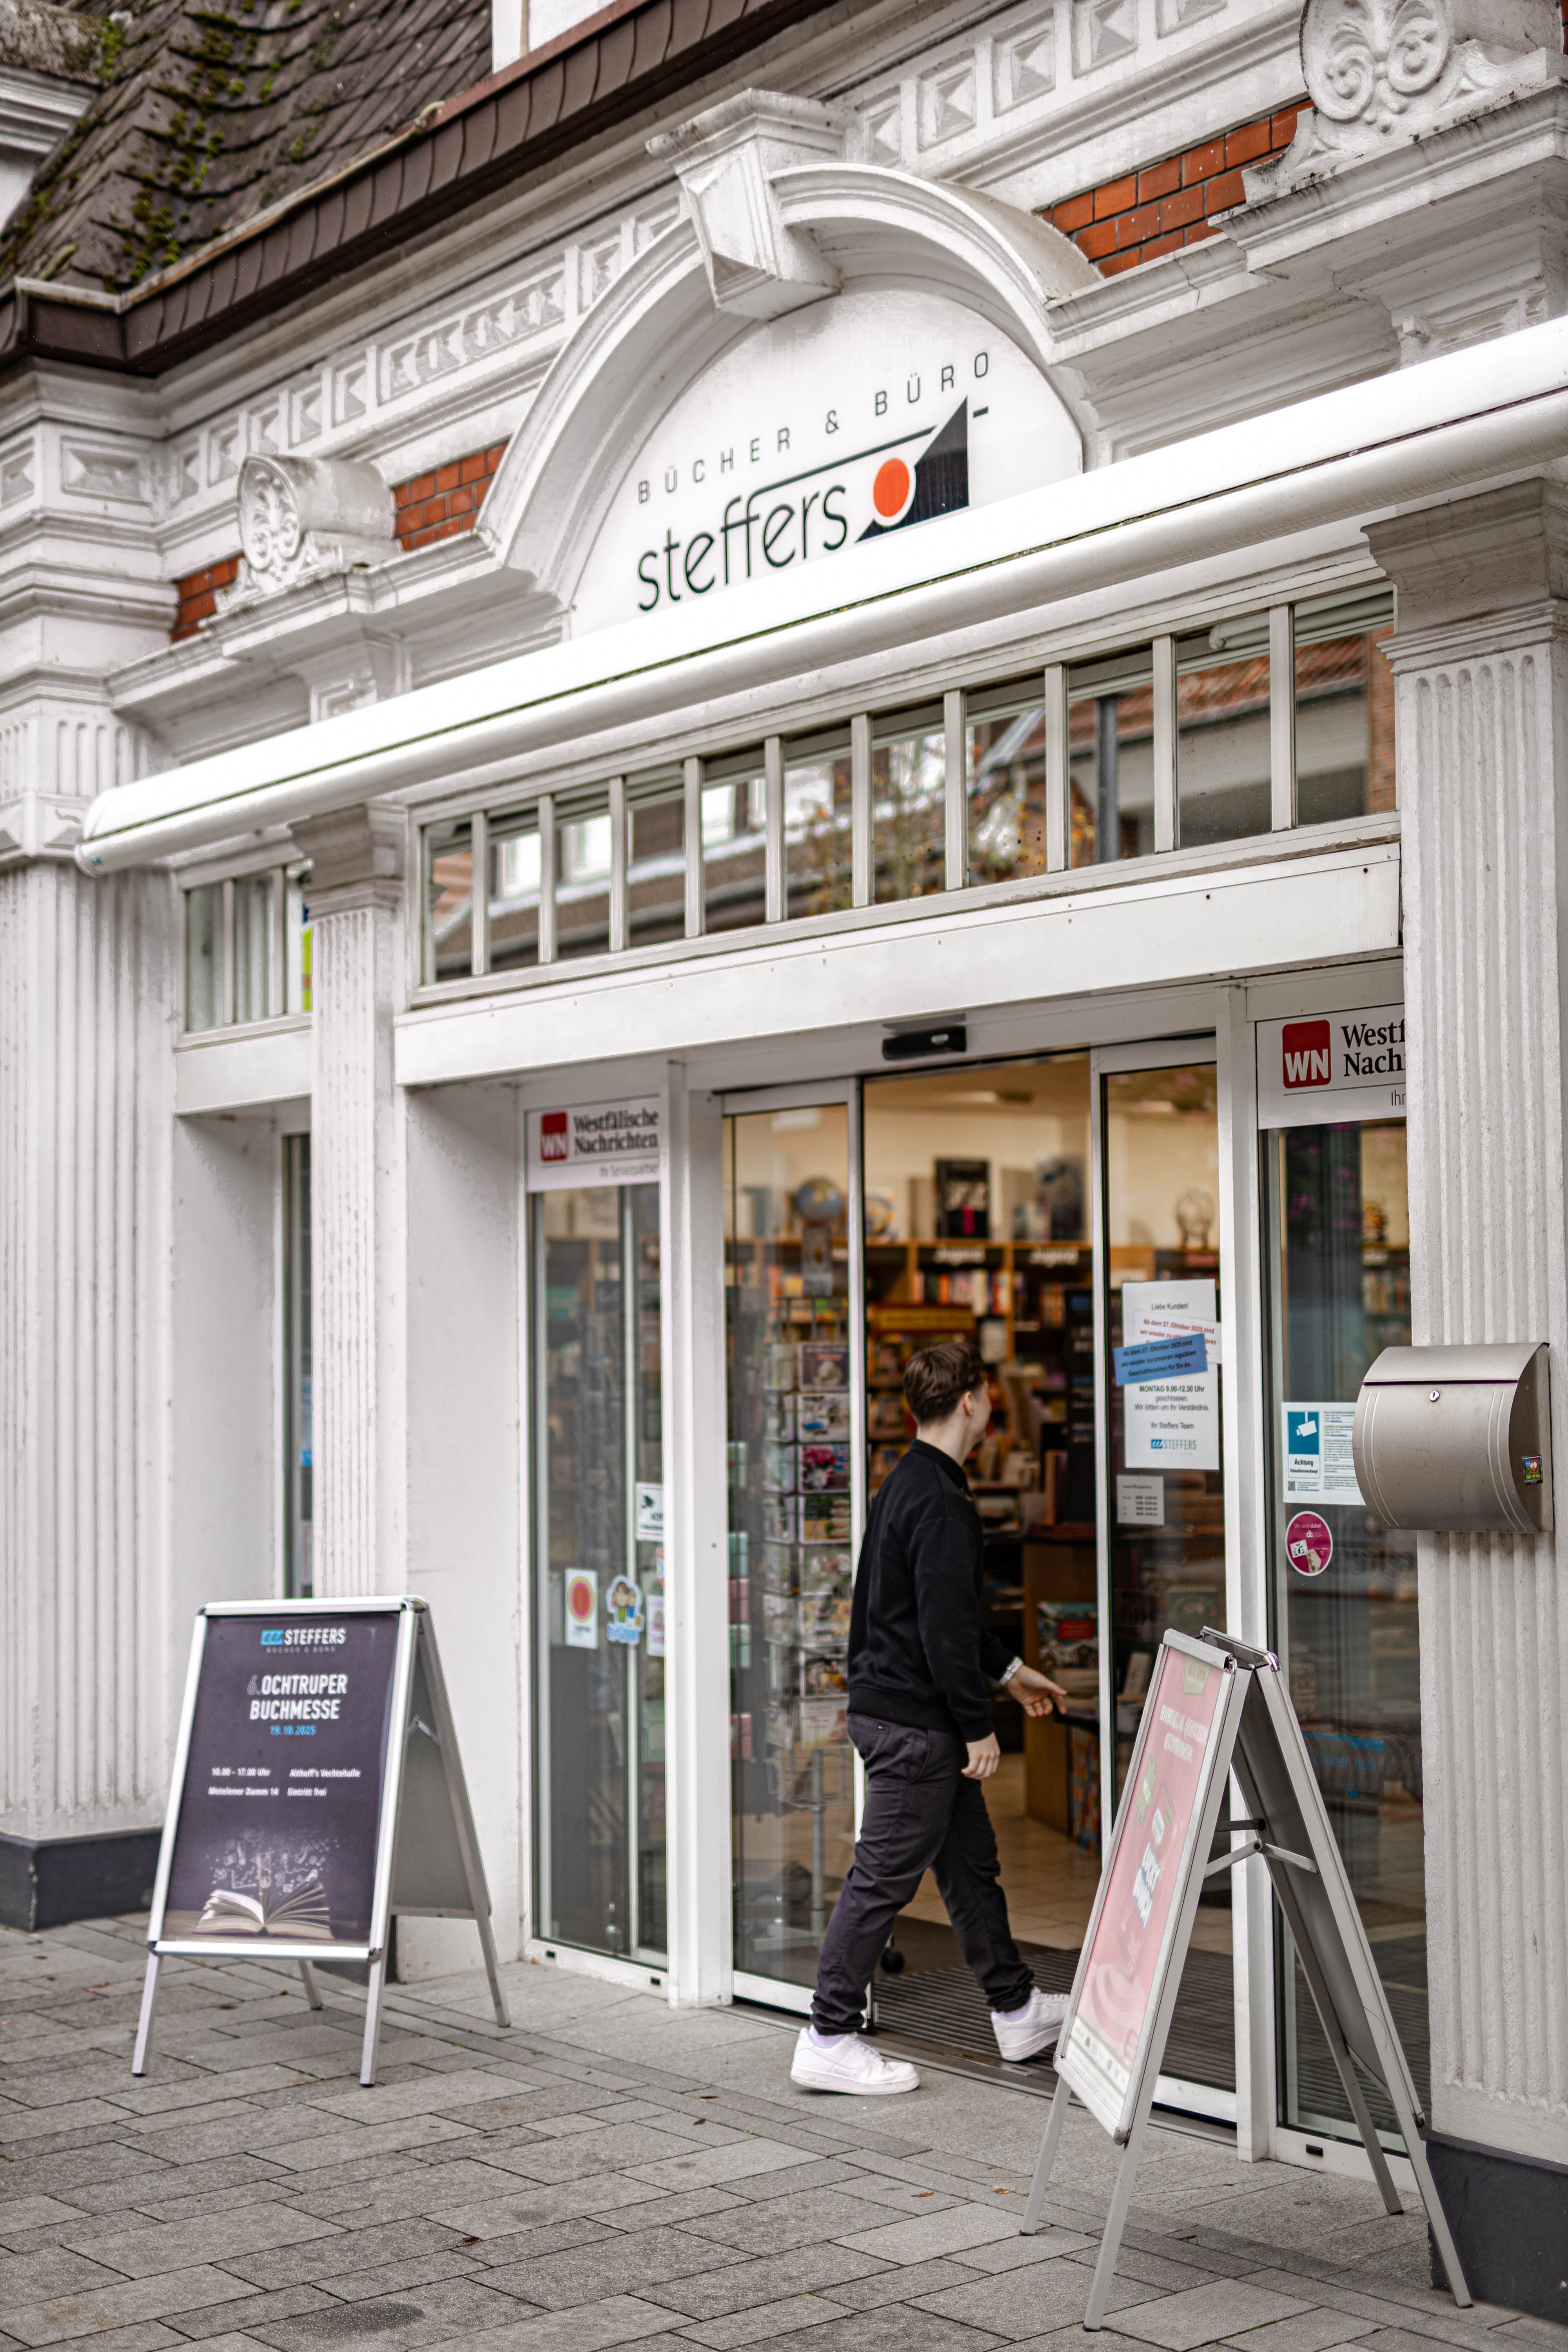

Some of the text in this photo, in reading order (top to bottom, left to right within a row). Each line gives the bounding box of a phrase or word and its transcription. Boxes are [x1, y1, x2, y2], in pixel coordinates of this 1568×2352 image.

[638, 352, 989, 504] BÜCHER & BÜRO
[637, 485, 849, 612] steffers
[1284, 1048, 1329, 1082] WN
[1343, 1047, 1406, 1077] Nach
[1391, 1090, 1406, 1106] Ihr
[573, 1107, 659, 1133] Westfälische
[541, 1134, 567, 1158] WN
[574, 1132, 659, 1155] Nachrichten
[1171, 1322, 1190, 1330] Oktober
[1163, 1439, 1197, 1450] STEFFERS
[1294, 1458, 1314, 1467] Achtung
[284, 1628, 347, 1646] STEFFERS
[261, 1674, 348, 1696] OCHTRUPER
[249, 1699, 341, 1720] BUCHMESSE
[269, 1725, 316, 1736] 19.10.2025
[257, 1768, 271, 1777] Uhr
[245, 1786, 268, 1796] Damm
